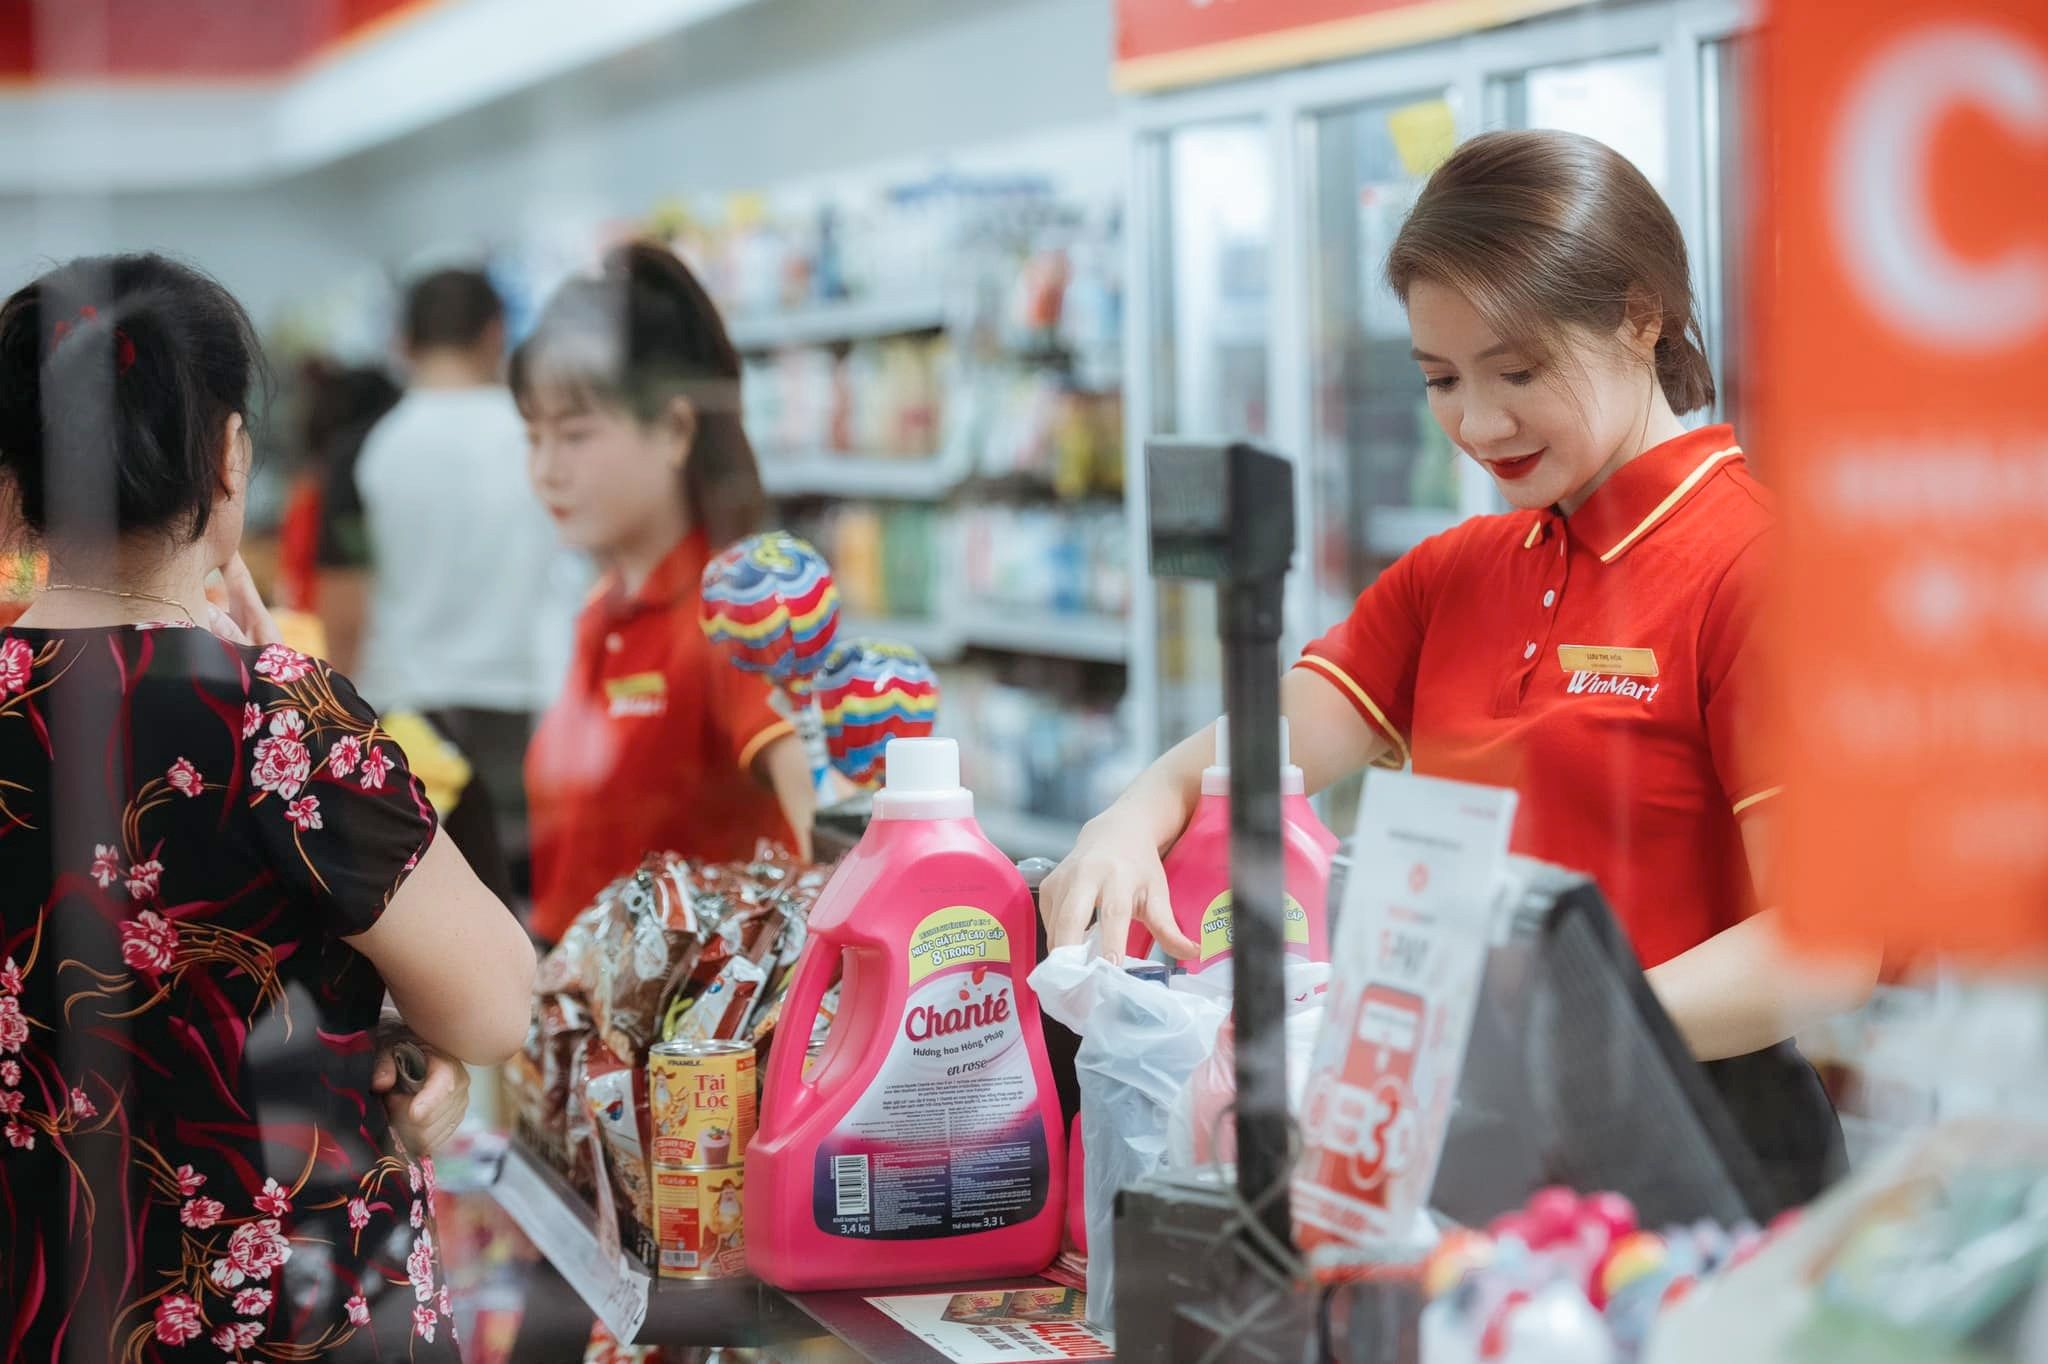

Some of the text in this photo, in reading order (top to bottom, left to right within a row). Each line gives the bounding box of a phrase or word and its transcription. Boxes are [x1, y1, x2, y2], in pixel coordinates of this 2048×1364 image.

[1566, 670, 1659, 702] WinMart
[968, 930, 985, 940] CAO
[932, 942, 986, 966] 8 TRONG 1
[905, 988, 1011, 1042] Chanté
[913, 1047, 942, 1058] Hương
[943, 1046, 959, 1056] hoa
[947, 1059, 987, 1077] en rose
[694, 1073, 726, 1092] Tài
[694, 1092, 729, 1113] Lộc
[841, 1222, 870, 1234] 3,4 kg
[983, 1215, 1005, 1227] 3,3 L
